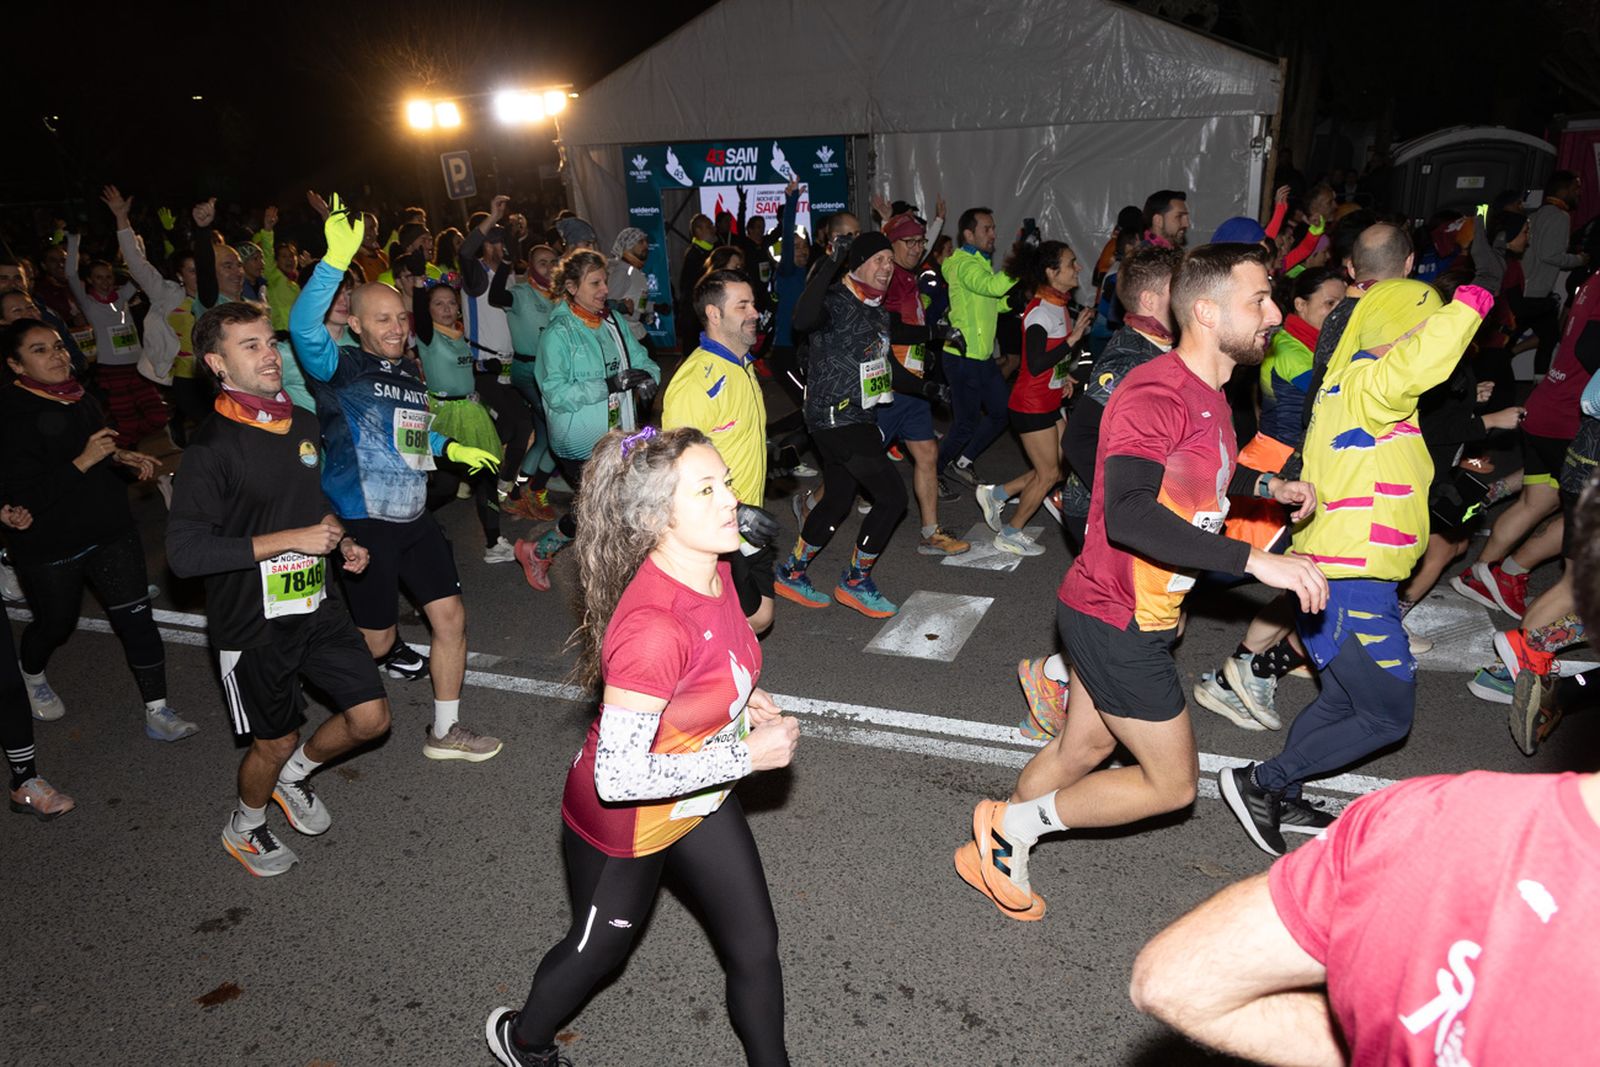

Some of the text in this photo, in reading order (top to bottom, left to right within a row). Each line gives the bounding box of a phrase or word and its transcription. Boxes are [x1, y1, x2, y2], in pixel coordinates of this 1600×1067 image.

[706, 147, 759, 165] 43 SAN
[448, 157, 467, 193] P
[703, 164, 757, 183] ANTÓN
[755, 201, 781, 214] SAN
[374, 382, 401, 400] SAN
[272, 564, 288, 574] SAN
[280, 563, 322, 594] 7846
